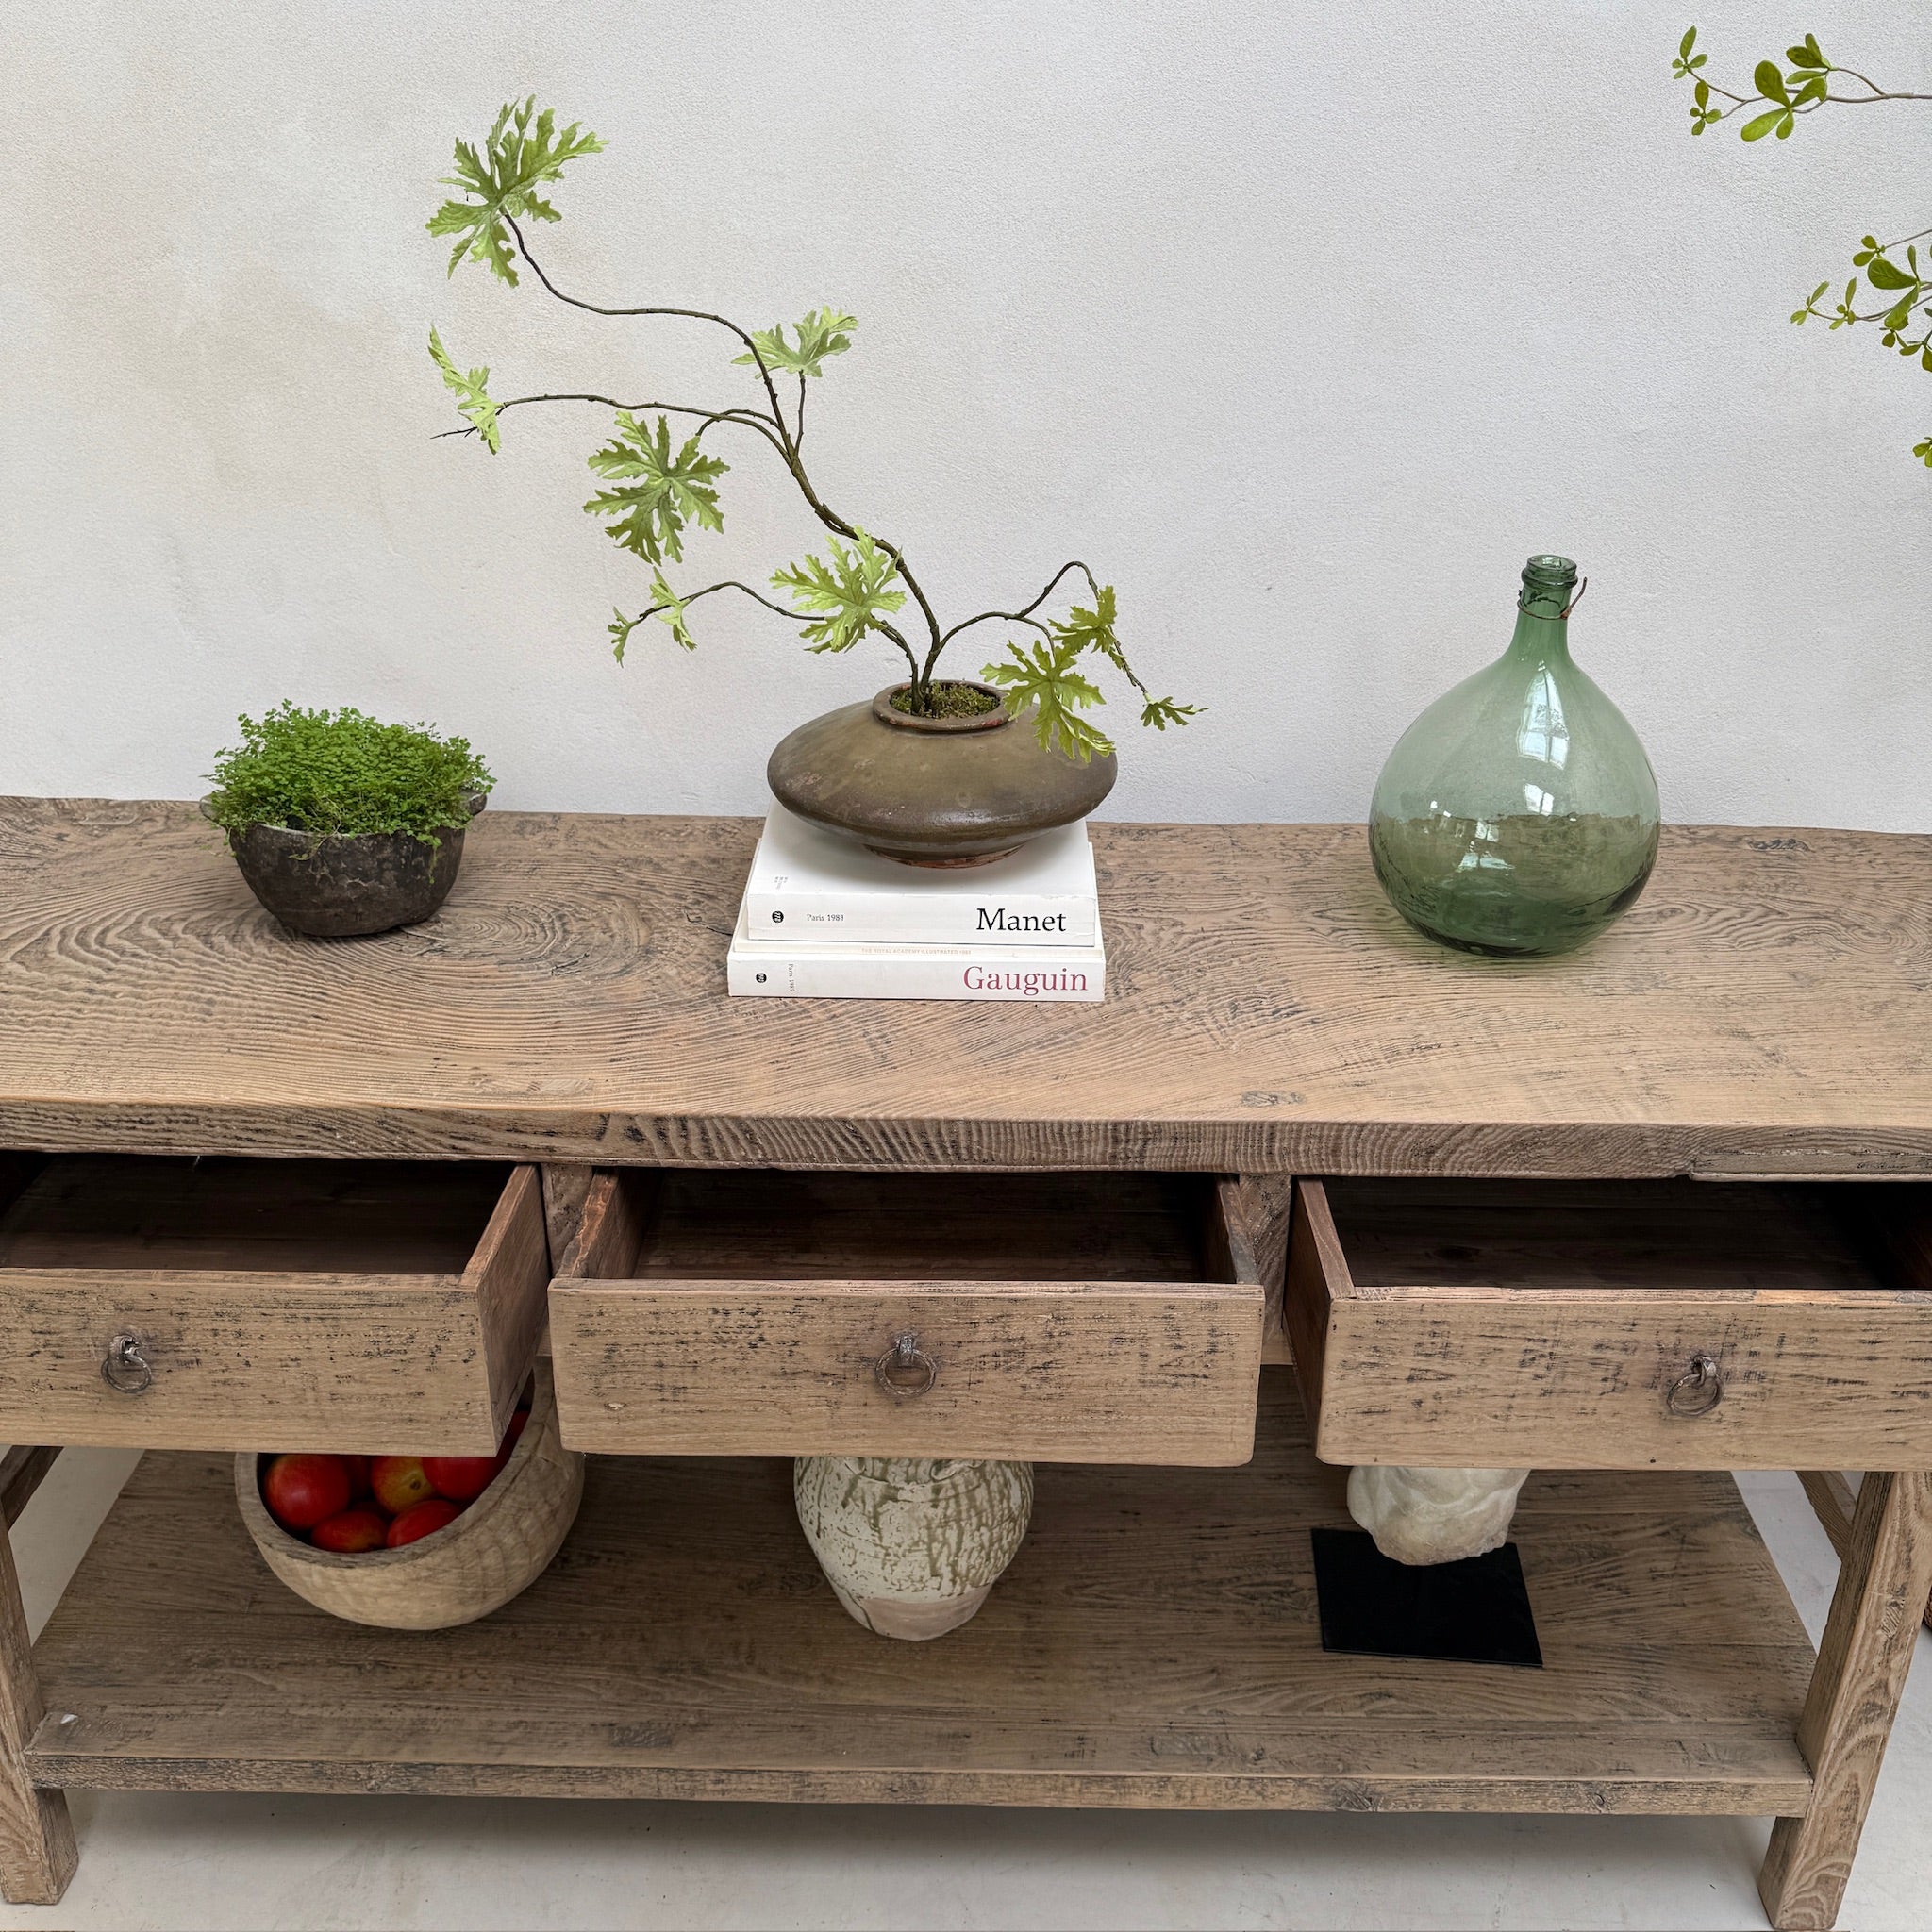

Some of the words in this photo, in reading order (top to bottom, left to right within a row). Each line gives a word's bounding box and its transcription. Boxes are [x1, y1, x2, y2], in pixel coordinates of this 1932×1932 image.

[807, 913, 824, 922] Paris
[976, 908, 1067, 932] Manet
[963, 965, 1088, 996] Gauguin
